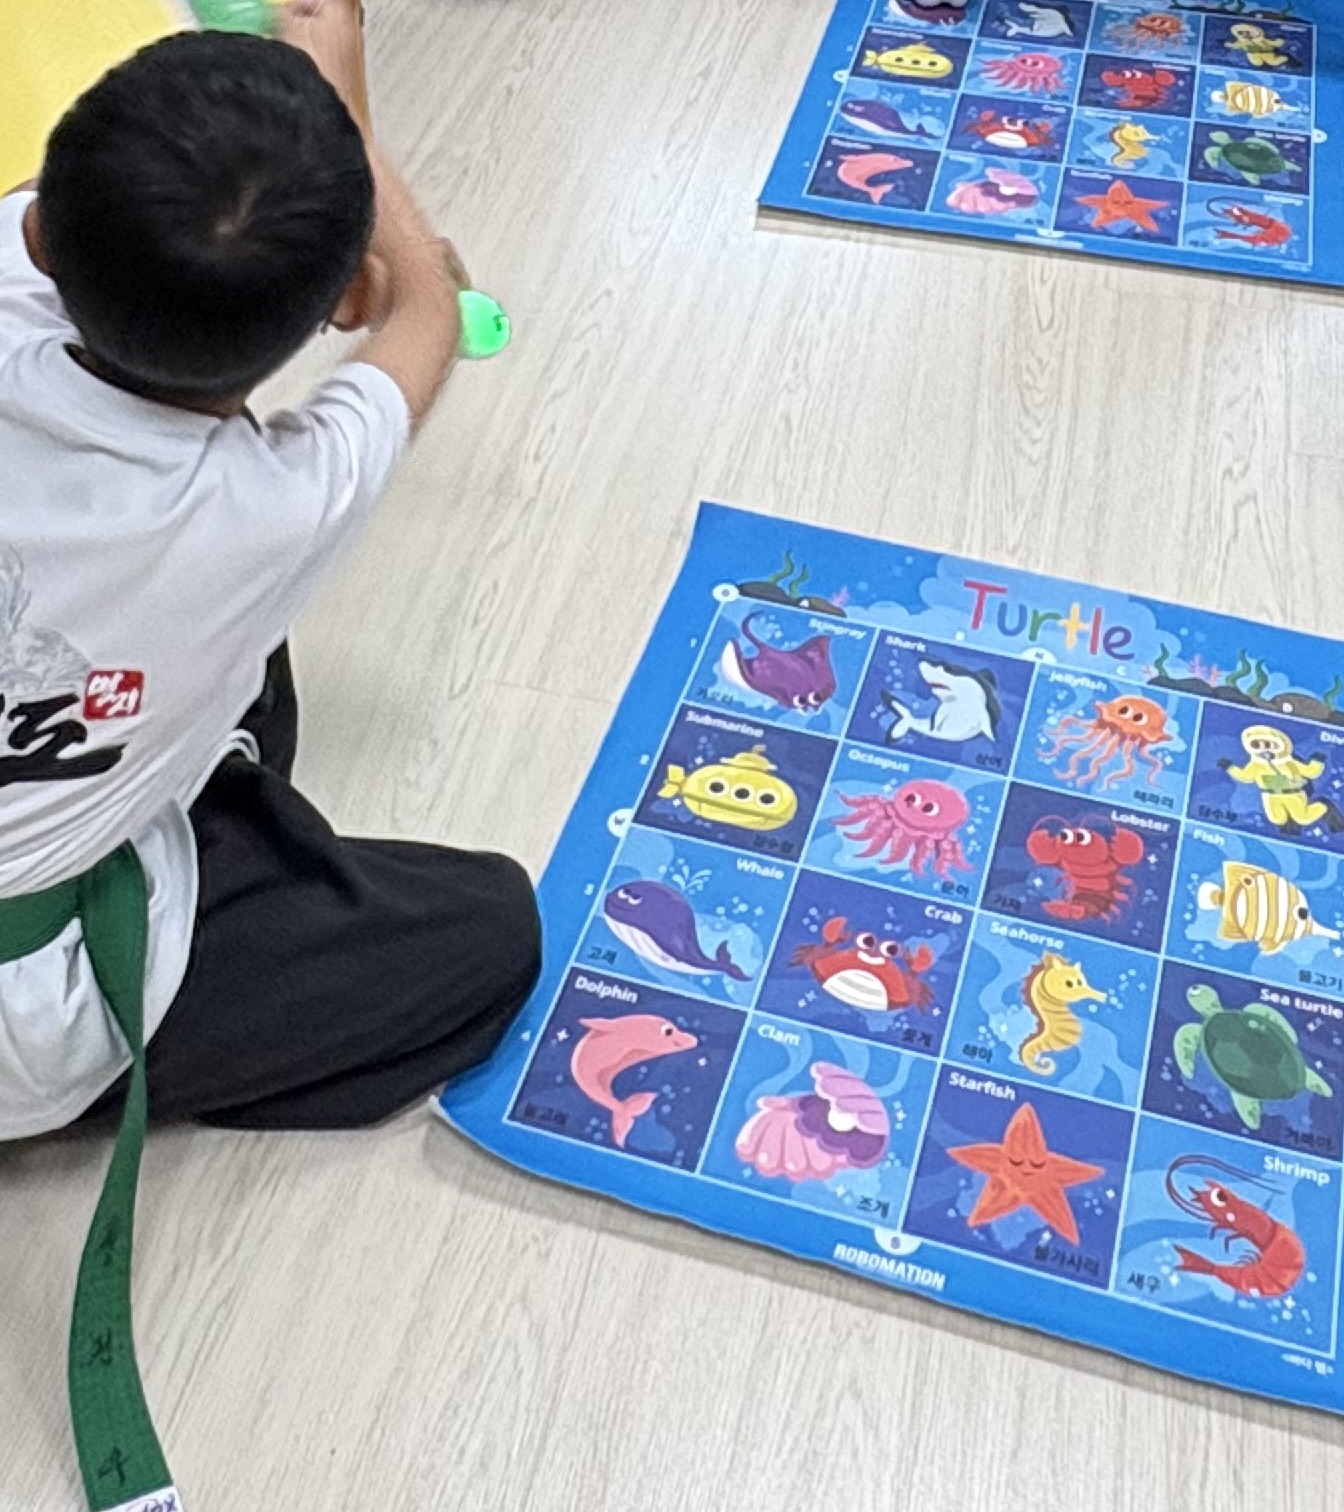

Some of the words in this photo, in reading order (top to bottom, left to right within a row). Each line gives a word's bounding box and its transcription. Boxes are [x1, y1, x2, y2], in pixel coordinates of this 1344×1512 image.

[809, 618, 867, 640] Stingray
[963, 579, 1136, 661] Turtle
[885, 634, 926, 653] Shark
[684, 710, 765, 738] Submarine
[847, 748, 911, 773] Octopus
[1110, 809, 1171, 834] Lobster
[1192, 828, 1226, 848] Fish
[736, 857, 785, 881] Whale
[923, 903, 964, 926] Crab
[988, 920, 1066, 950] Seahorse
[574, 974, 639, 1004] Dolphin
[1259, 987, 1292, 1010] Sea
[1294, 994, 1344, 1021] turtle
[757, 1022, 802, 1048] Clam
[948, 1070, 1017, 1103] Starfish
[1263, 1154, 1332, 1186] Shrimp
[855, 1195, 891, 1220] 조개
[832, 1241, 946, 1290] ROBOMATION
